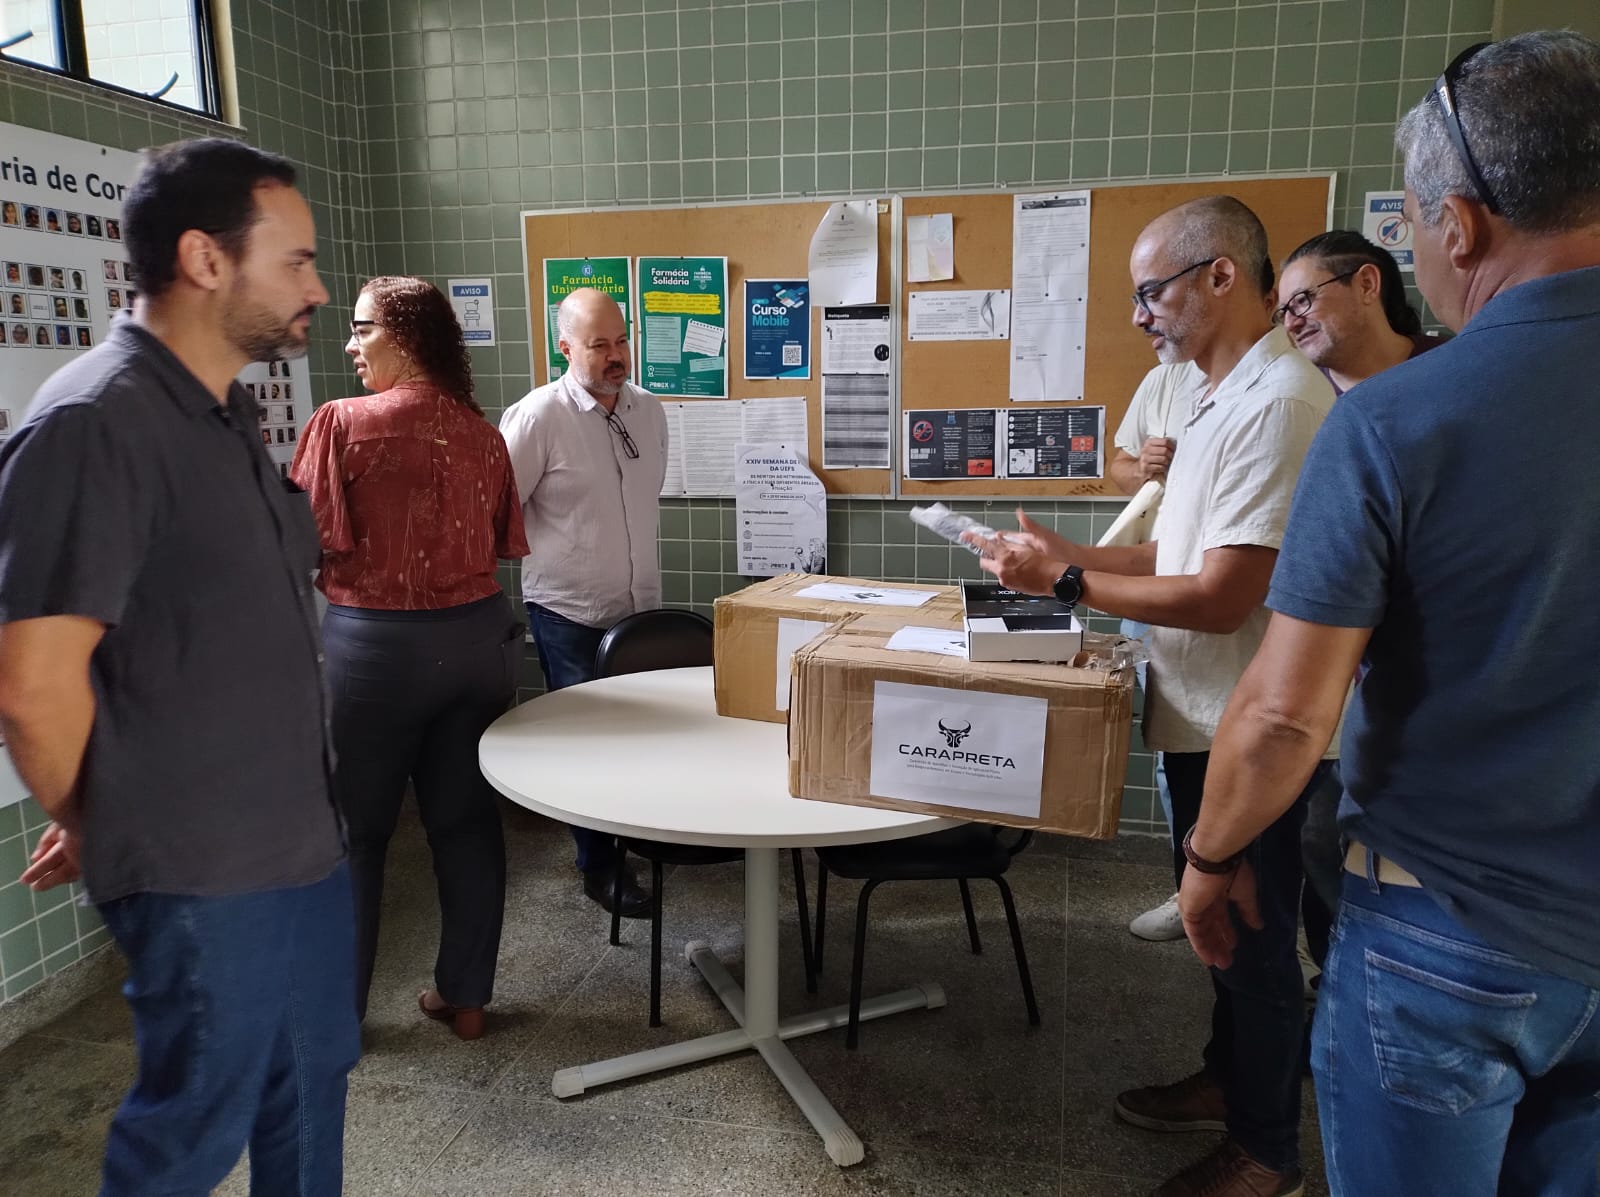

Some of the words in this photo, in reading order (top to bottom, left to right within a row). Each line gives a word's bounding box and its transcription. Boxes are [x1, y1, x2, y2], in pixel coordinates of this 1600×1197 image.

[46, 164, 78, 193] de
[1380, 202, 1403, 210] AVIS
[651, 267, 689, 277] Farmácia
[562, 274, 613, 285] Farmácia
[652, 277, 690, 286] Solidária
[460, 287, 482, 295] AVISO
[752, 303, 787, 316] Curso
[752, 315, 790, 326] Mobile
[898, 743, 1017, 769] CARAPRETA
